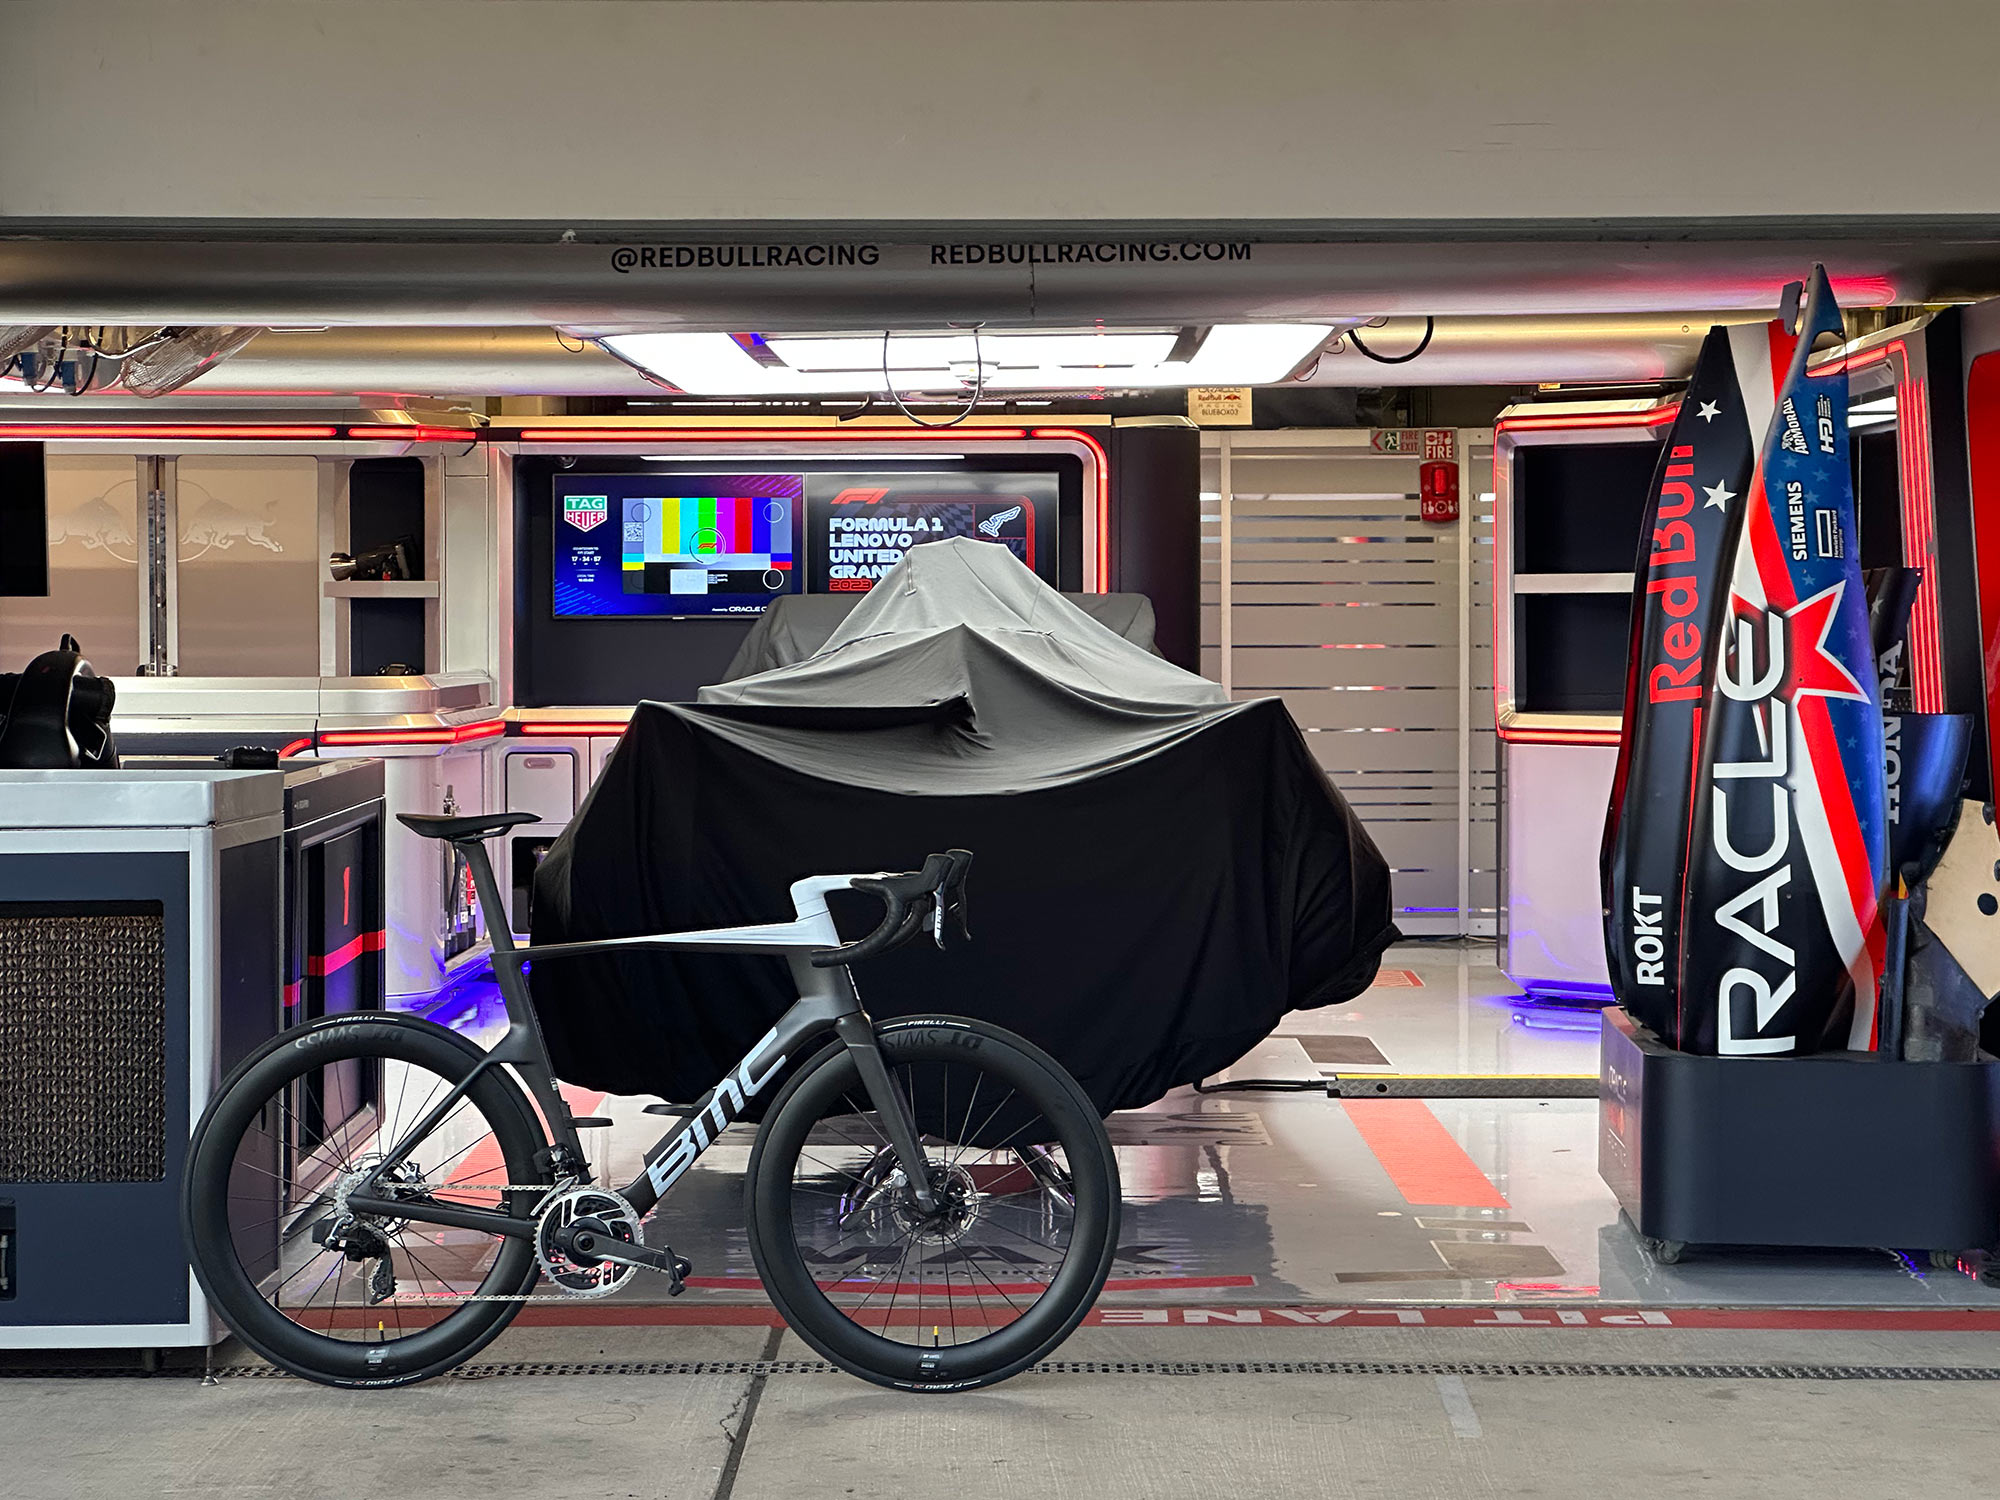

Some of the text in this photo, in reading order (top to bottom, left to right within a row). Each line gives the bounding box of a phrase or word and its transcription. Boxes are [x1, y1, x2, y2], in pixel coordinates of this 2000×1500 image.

[611, 245, 880, 274] @REDBULLRACING
[931, 243, 1252, 265] REDBULLRACING.COM
[1401, 431, 1419, 440] FIRE
[1401, 443, 1419, 452] EXIT
[1425, 445, 1453, 459] FIRE
[567, 498, 604, 509] TAG
[566, 512, 605, 529] HEUER
[829, 517, 944, 532] FORMULA 1
[1786, 481, 1808, 561] SIEMENS
[829, 533, 913, 547] LENOVO
[829, 548, 904, 563] UNITED
[829, 564, 895, 579] GRAN
[830, 580, 872, 590] 2023
[1646, 576, 1703, 704] Red
[1632, 885, 1665, 986] ROKT
[336, 1015, 375, 1023] PIRELLI
[1099, 1309, 1673, 1325] PIT LANE
